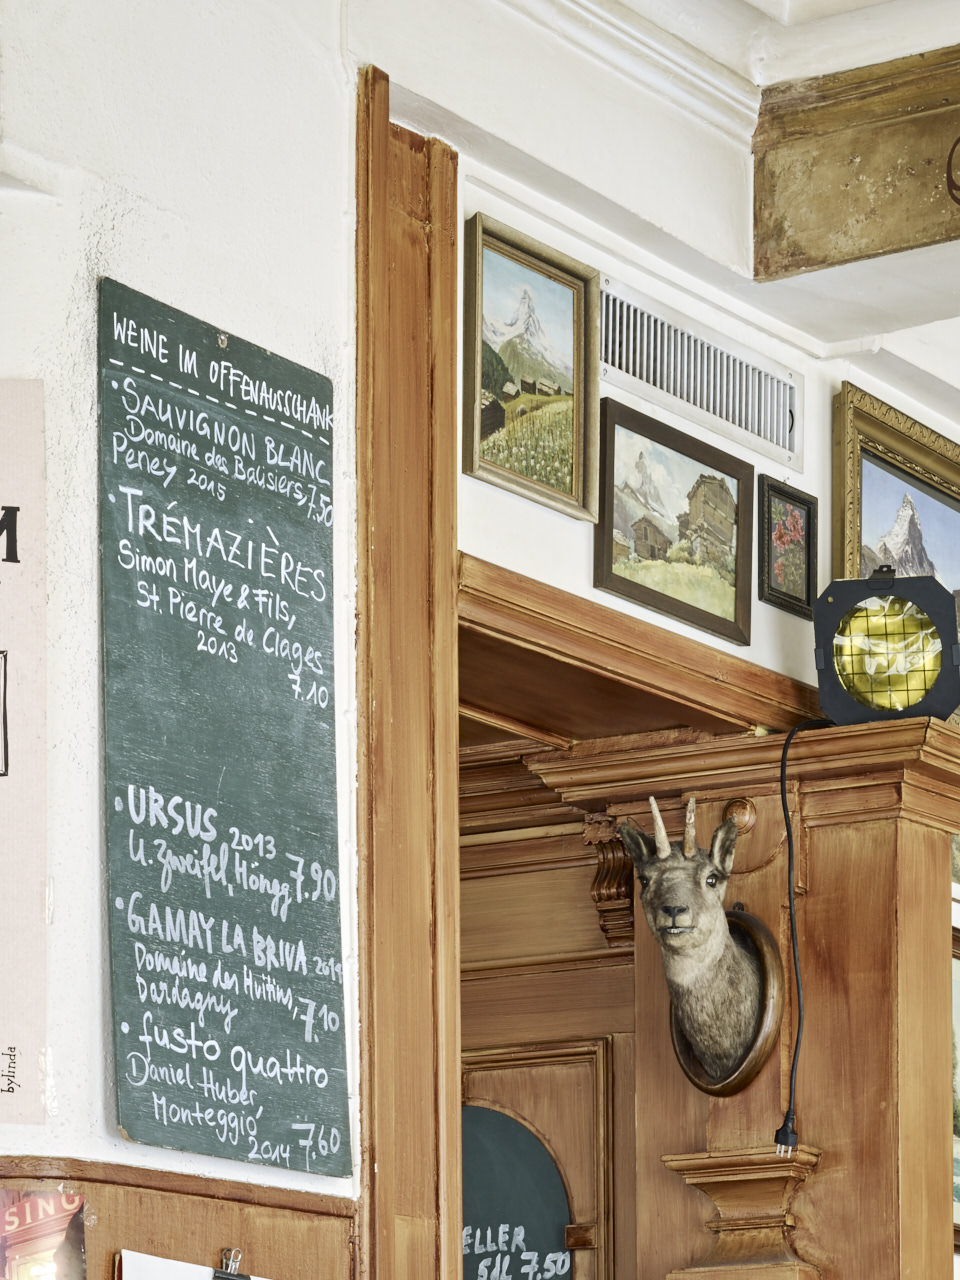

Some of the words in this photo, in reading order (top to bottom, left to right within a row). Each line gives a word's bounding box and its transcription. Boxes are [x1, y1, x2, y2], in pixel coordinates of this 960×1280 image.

[113, 311, 169, 364] WEINE
[179, 344, 199, 378] IM
[121, 377, 256, 460] SAUVIGNON
[264, 436, 331, 486] BLANC
[113, 431, 177, 488] Peney
[187, 468, 227, 501] 2015
[124, 415, 200, 460] Domaine
[205, 446, 229, 475] des
[306, 484, 334, 529] 7.50
[118, 484, 327, 602] TRÉMAZIÈRES
[118, 539, 177, 582] Simon
[184, 557, 233, 608] Maye
[237, 584, 249, 610] &
[252, 589, 296, 631] Fils,
[136, 580, 163, 615] St.
[167, 587, 228, 635] Pierre
[234, 618, 254, 647] de
[262, 626, 323, 675] Clages
[197, 630, 238, 664] 2013
[288, 673, 329, 708] 7.10
[128, 783, 218, 842] URSUS
[228, 827, 277, 860] 2013
[285, 852, 336, 904] 7.90
[127, 891, 215, 954] GAMAY
[221, 919, 248, 958] LA
[252, 925, 308, 976] BRIVA
[135, 942, 207, 982] Domaine
[126, 1051, 194, 1089] Daniel
[230, 1046, 329, 1090] quattro
[248, 1136, 290, 1168] 2014
[291, 1122, 341, 1173] 7.60
